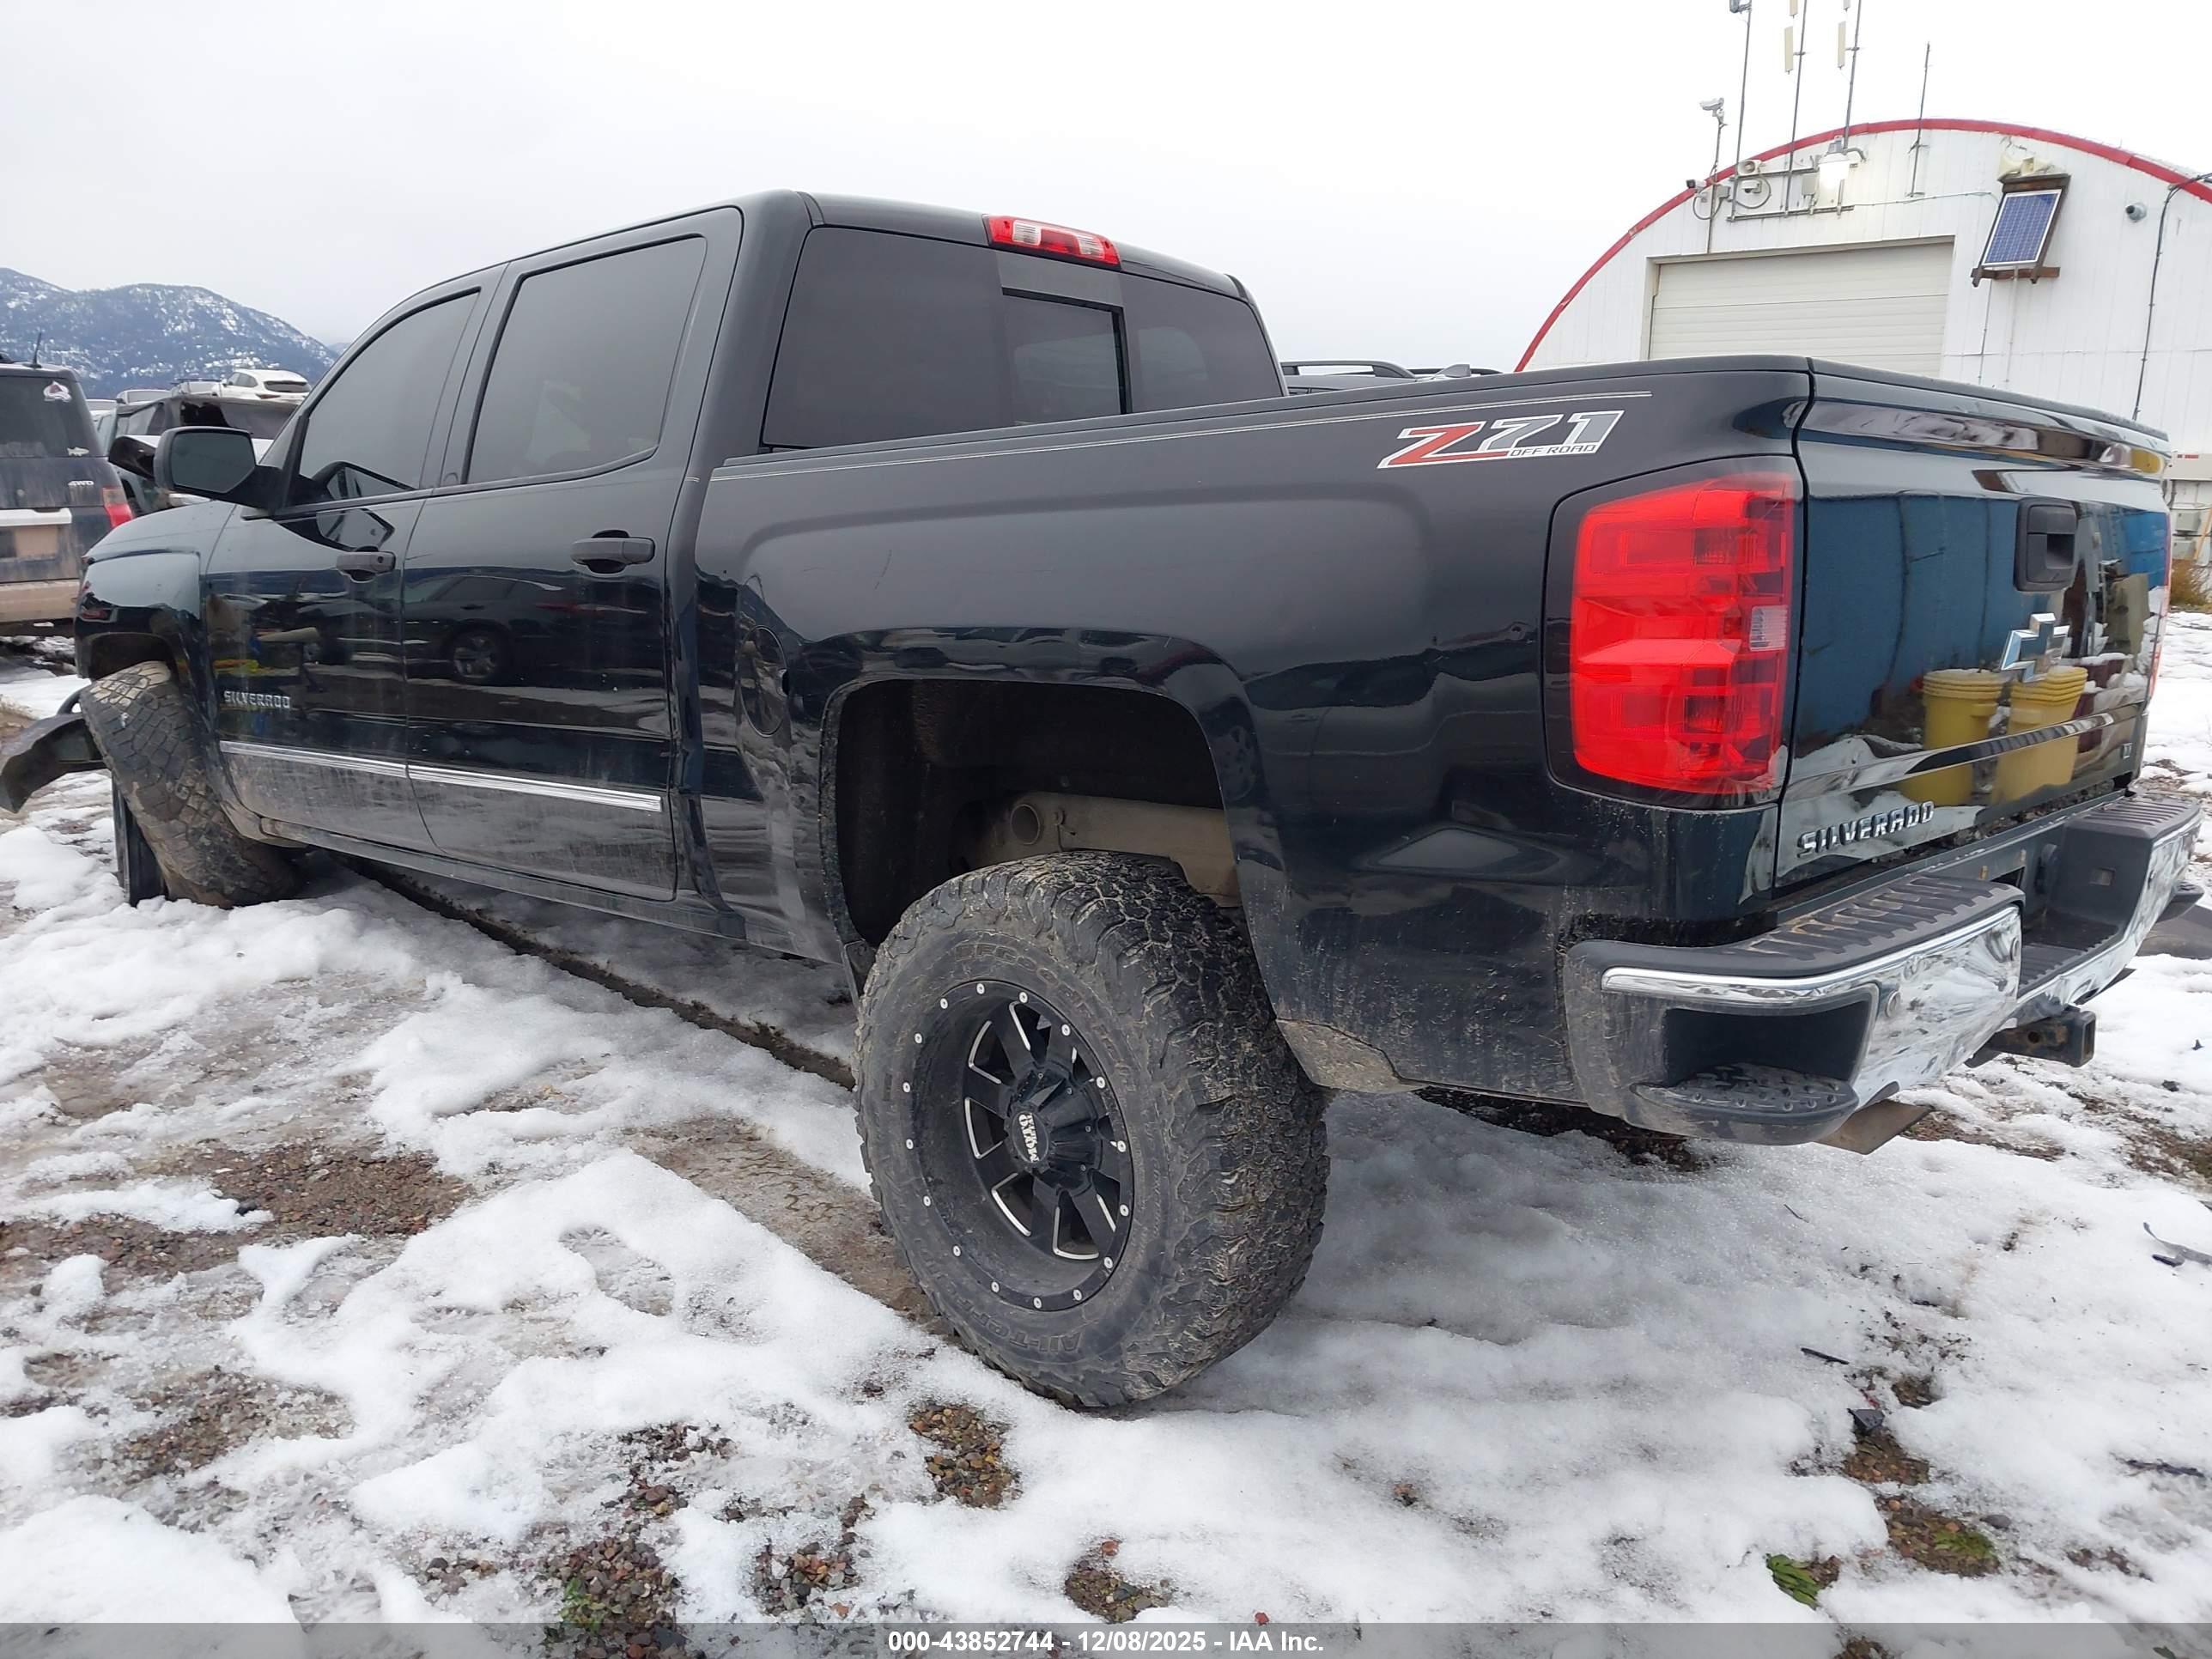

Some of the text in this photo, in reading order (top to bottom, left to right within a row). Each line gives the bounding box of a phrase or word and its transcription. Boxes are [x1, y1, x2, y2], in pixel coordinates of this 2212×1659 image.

[1376, 410, 1625, 469] Z71
[1510, 444, 1597, 457] OFF ROAD
[224, 690, 291, 708] SILVERADO
[1797, 800, 1935, 857] SILVERADO
